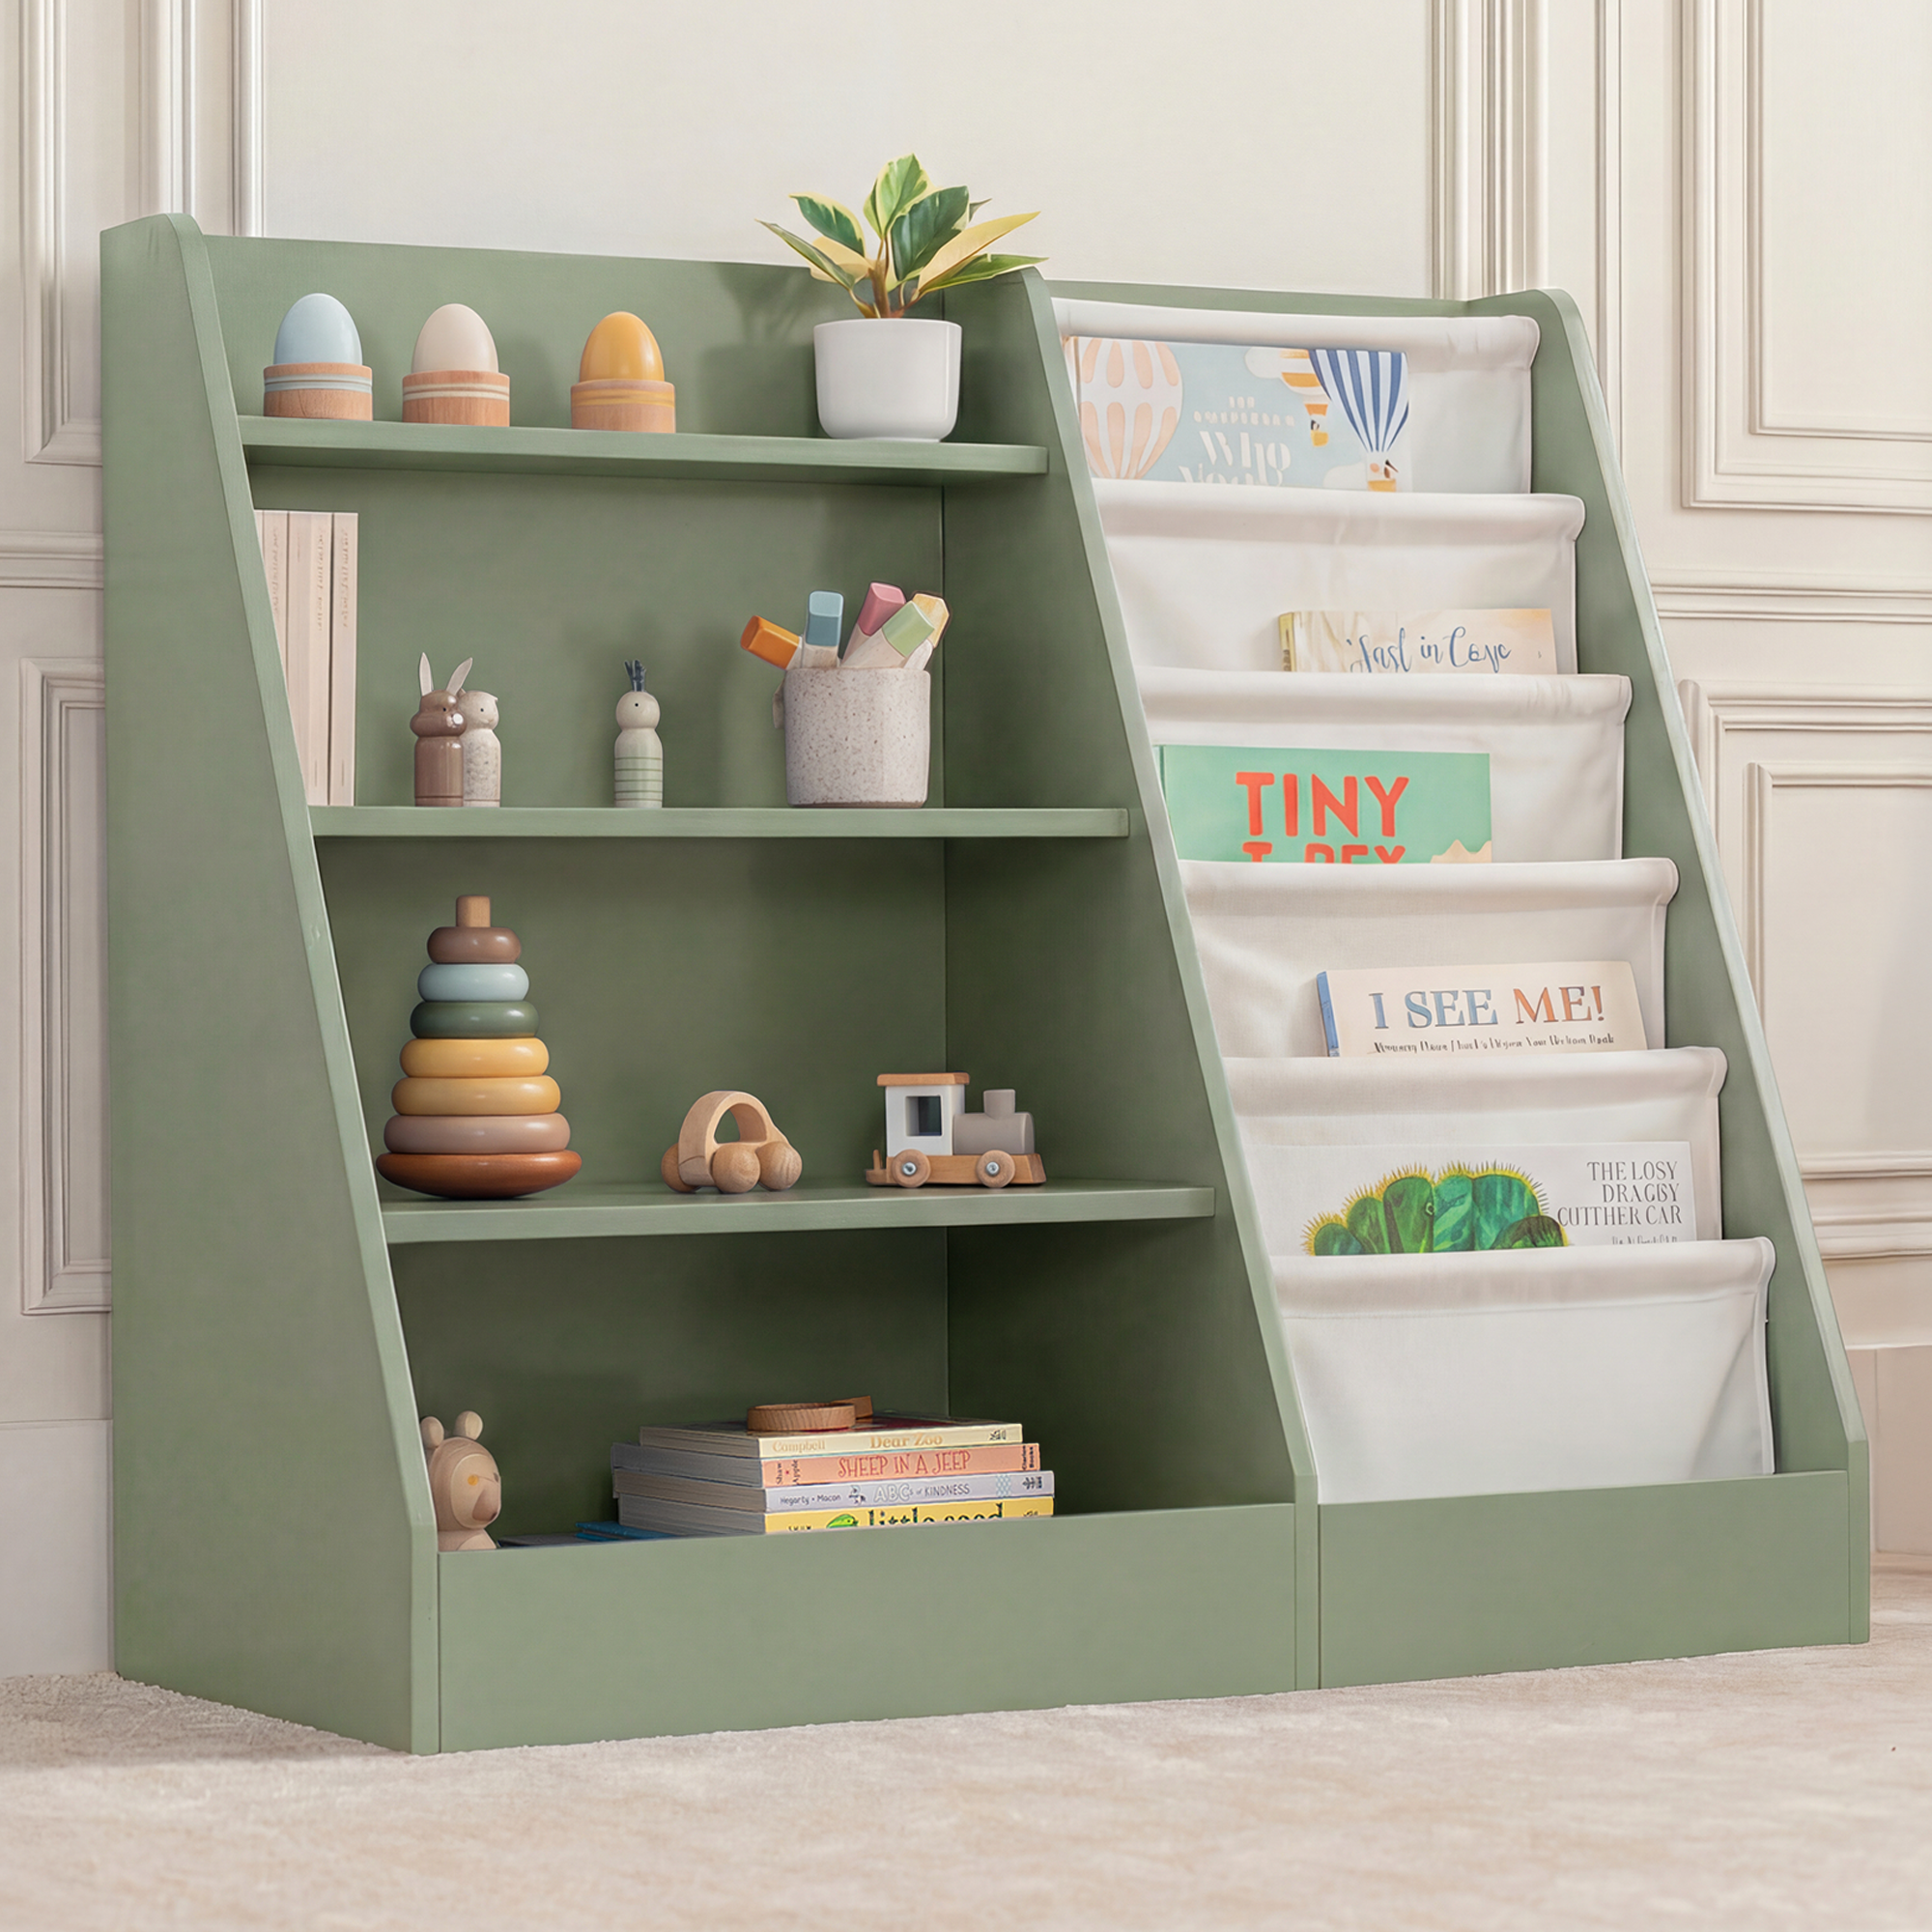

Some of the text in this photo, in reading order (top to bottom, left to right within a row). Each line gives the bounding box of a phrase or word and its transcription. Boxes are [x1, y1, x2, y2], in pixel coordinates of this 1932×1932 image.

[1420, 636, 1443, 664] in
[1236, 772, 1410, 838] TINY
[1369, 985, 1605, 1029] I SEE ME!
[1587, 1161, 1627, 1180] THE
[1645, 1205, 1682, 1225] CAR
[772, 1438, 826, 1453] Campbell
[870, 1433, 943, 1449] Dear Zoo
[838, 1450, 971, 1479] SHEEP IN A JEEP
[924, 1483, 970, 1496] KINDNESS
